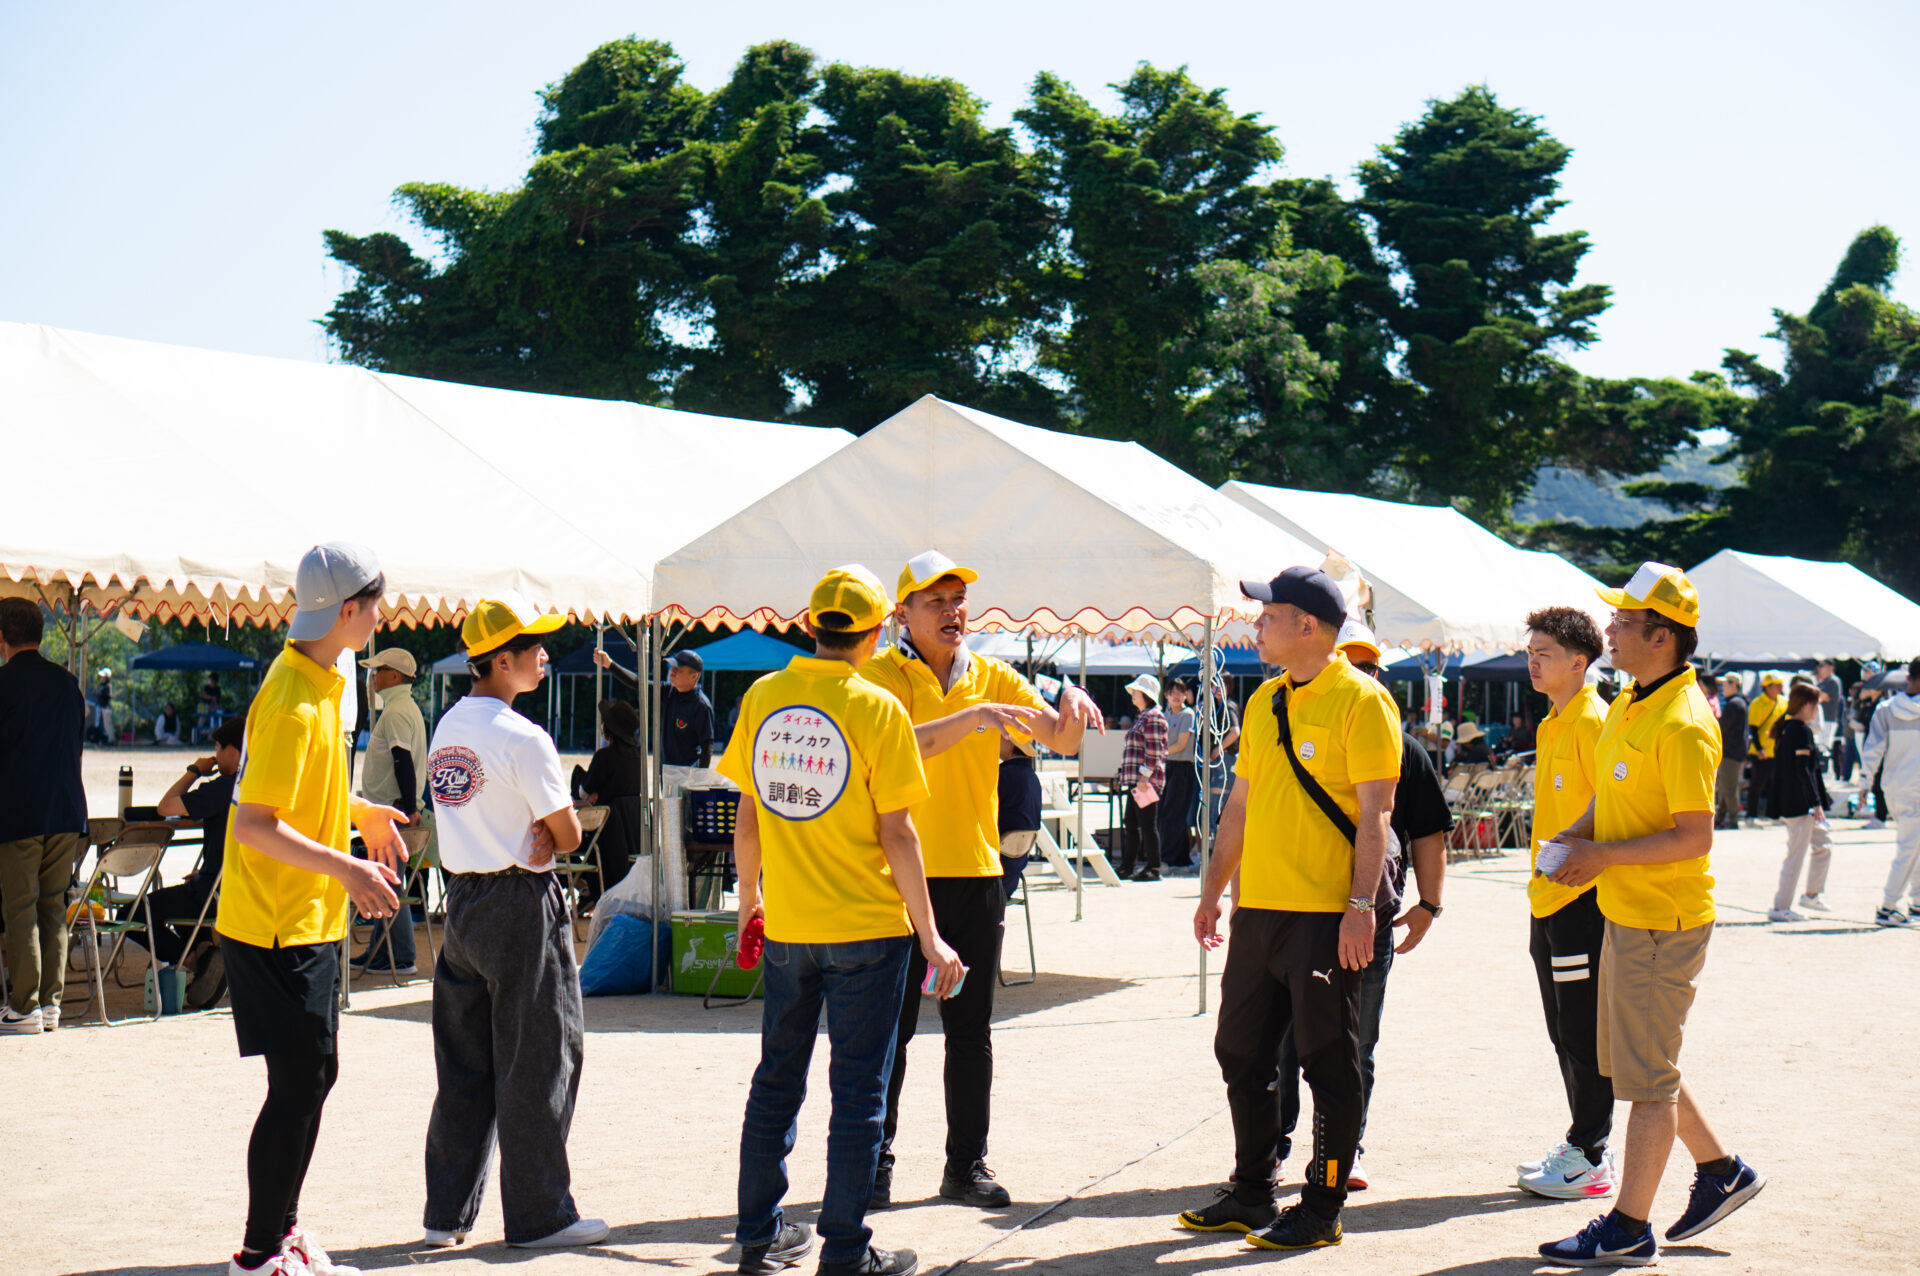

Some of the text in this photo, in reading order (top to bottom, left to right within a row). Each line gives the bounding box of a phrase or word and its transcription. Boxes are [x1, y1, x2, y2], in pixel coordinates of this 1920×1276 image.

[784, 714, 822, 727] ダイスキ
[770, 730, 831, 748] ツキノカワ
[768, 781, 822, 808] 調創会
